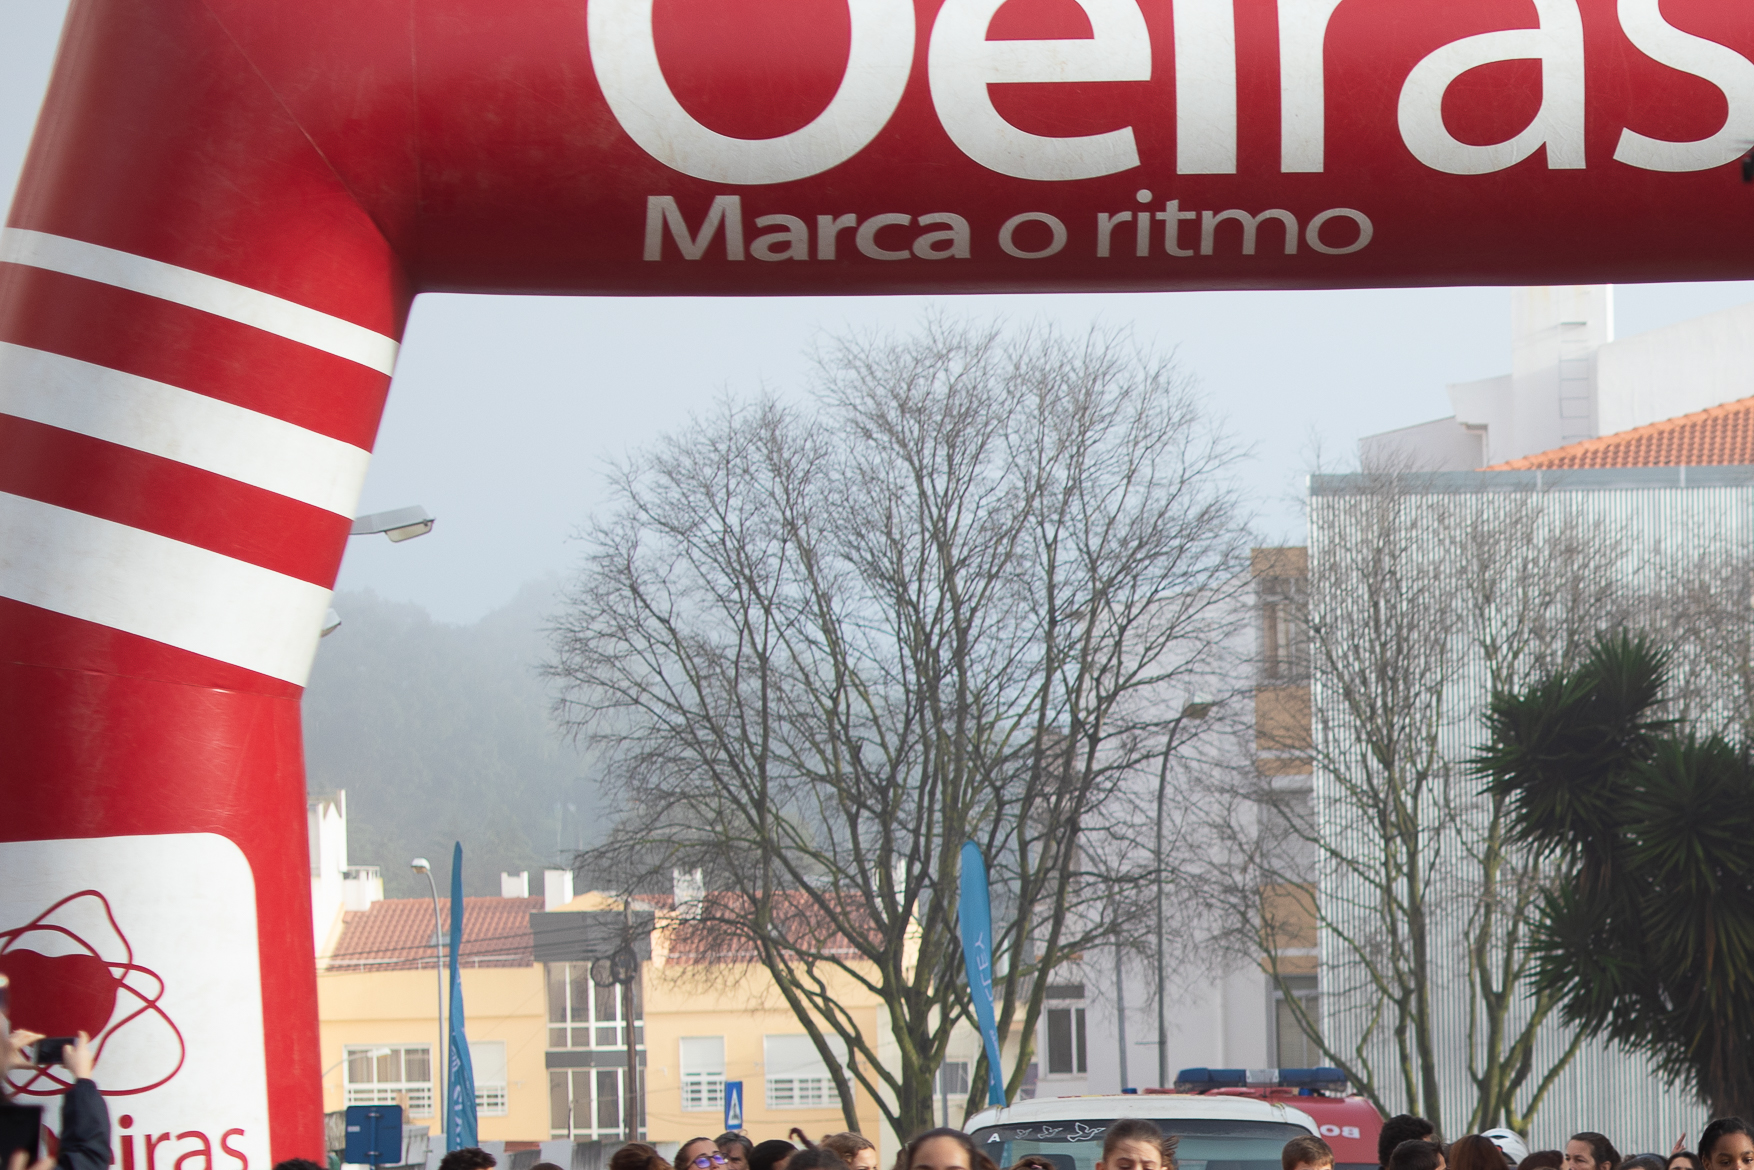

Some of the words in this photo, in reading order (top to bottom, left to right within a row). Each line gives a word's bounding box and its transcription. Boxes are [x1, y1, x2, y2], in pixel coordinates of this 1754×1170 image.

[642, 194, 971, 262] Marca
[998, 208, 1068, 259] o
[1093, 189, 1374, 258] ritmo
